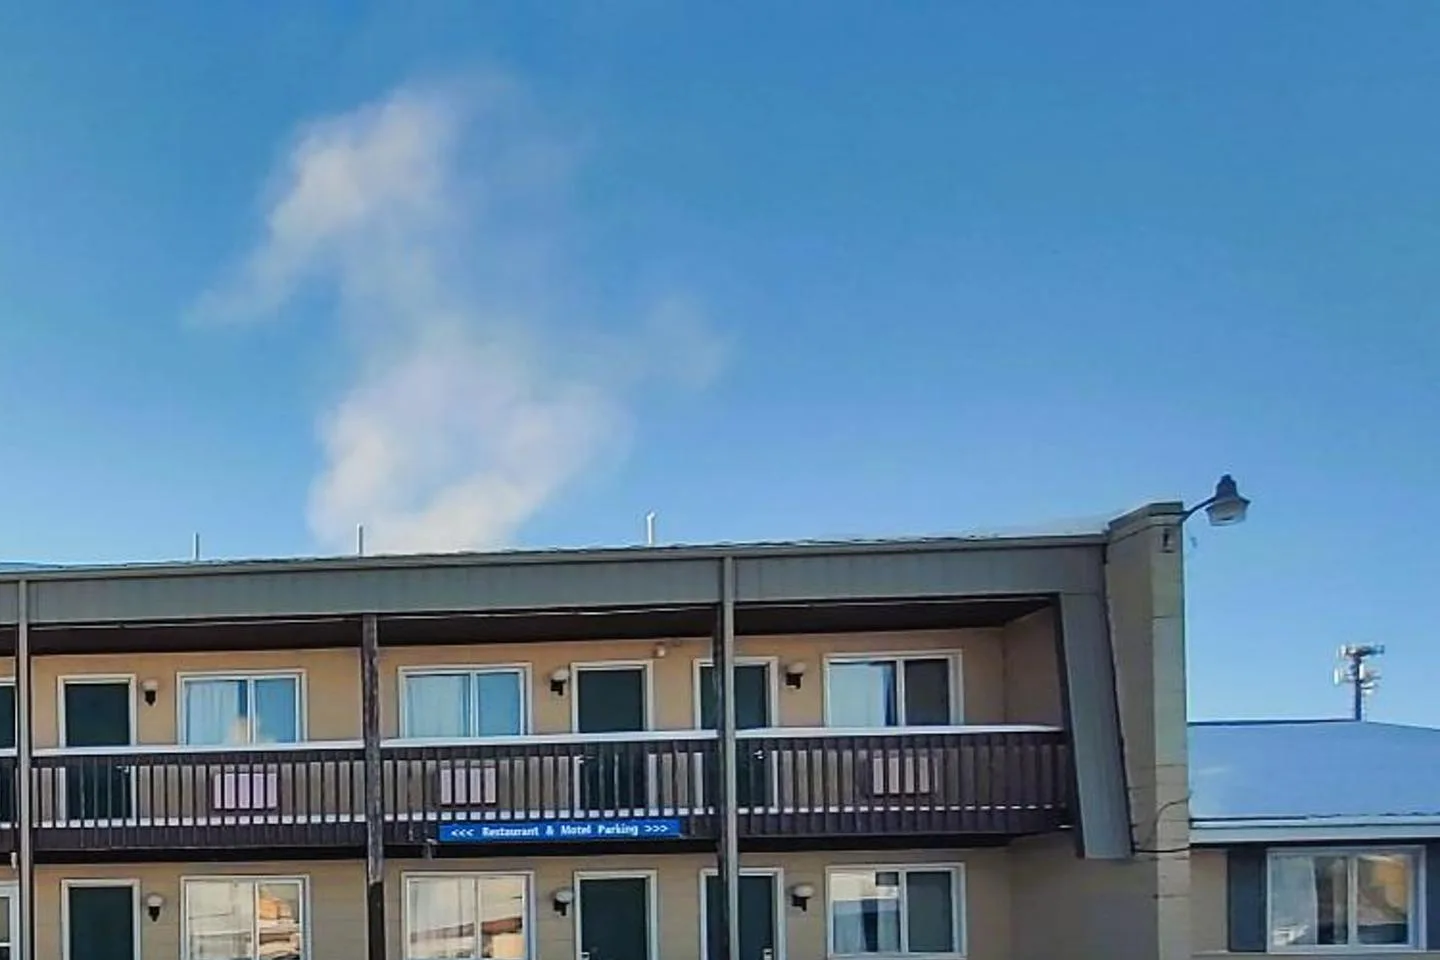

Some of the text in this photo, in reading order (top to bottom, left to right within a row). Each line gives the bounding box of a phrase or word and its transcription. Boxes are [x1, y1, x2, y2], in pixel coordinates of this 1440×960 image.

[481, 823, 638, 837] Restaurant & Motel Parking
